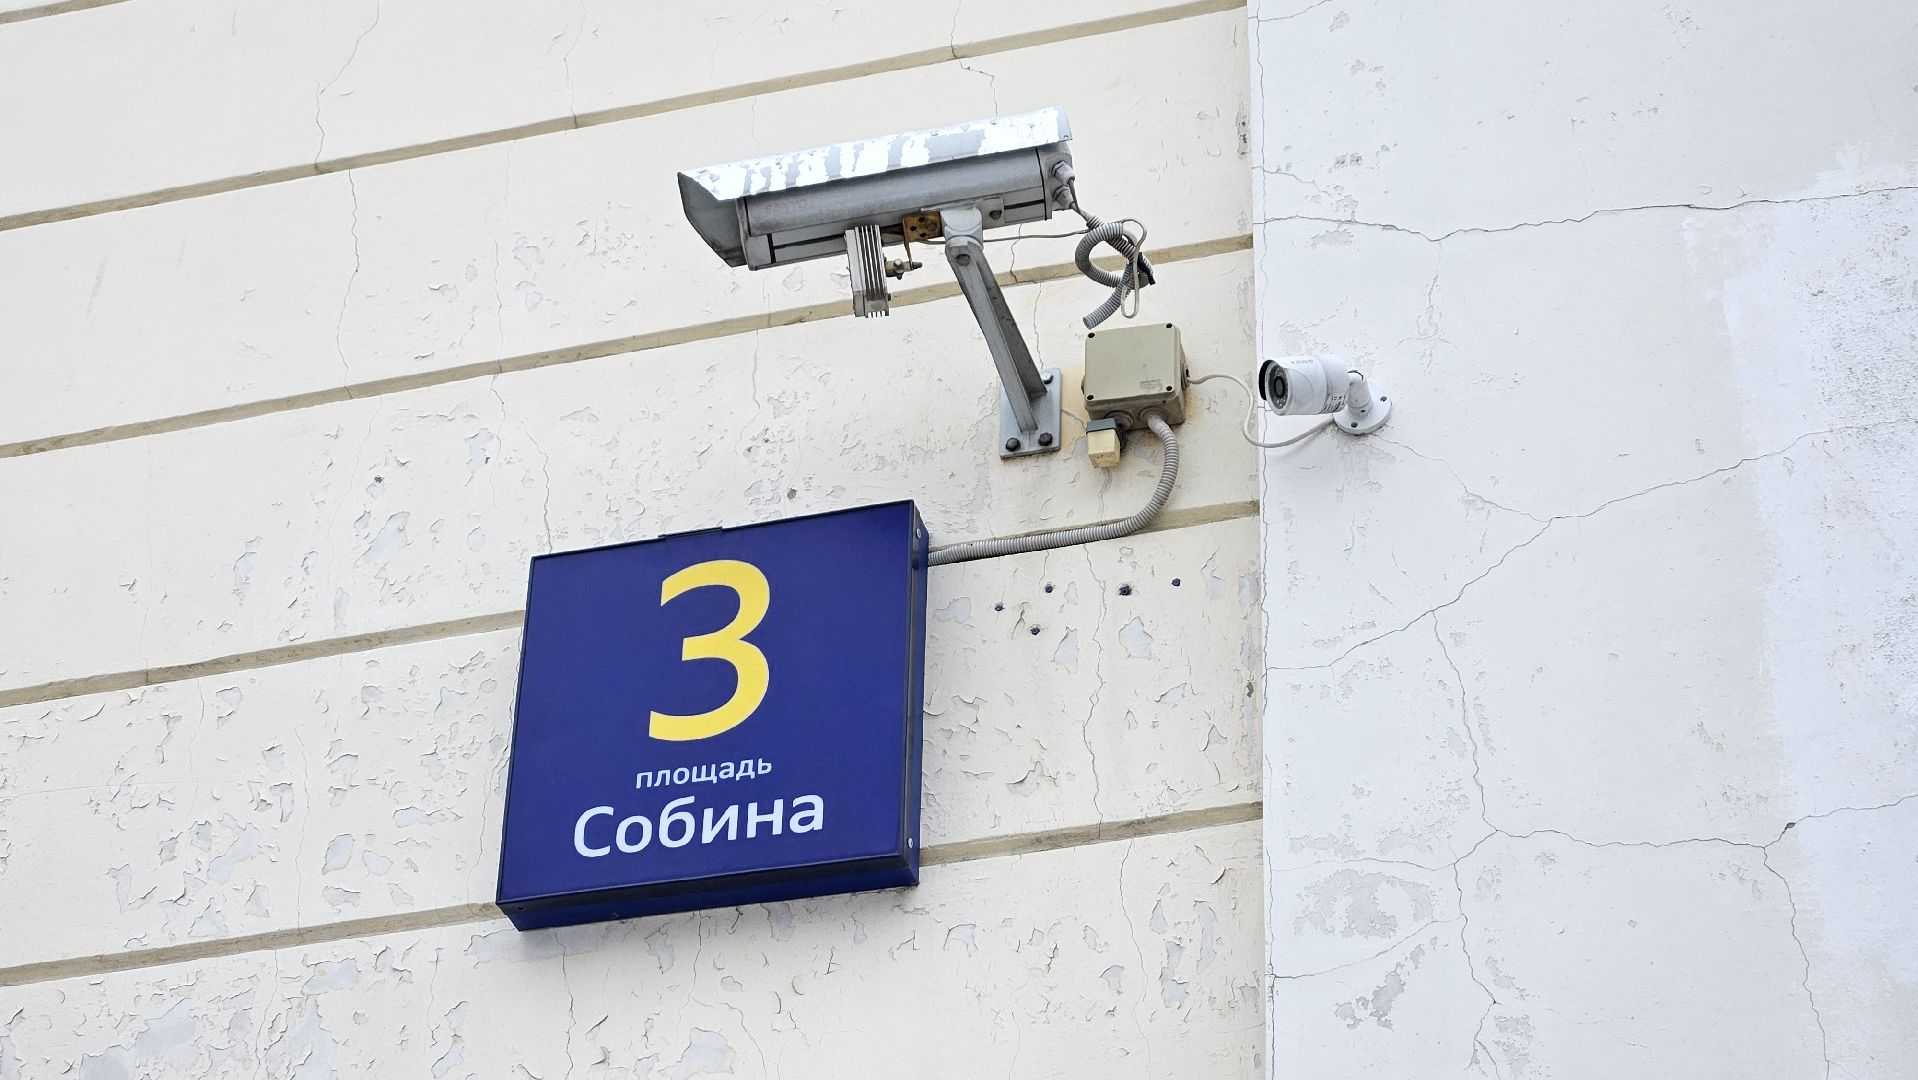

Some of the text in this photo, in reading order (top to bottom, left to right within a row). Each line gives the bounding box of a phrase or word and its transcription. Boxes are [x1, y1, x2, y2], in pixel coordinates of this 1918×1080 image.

[649, 560, 771, 741] 3
[635, 757, 773, 789] площадь
[573, 794, 824, 857] Собина
